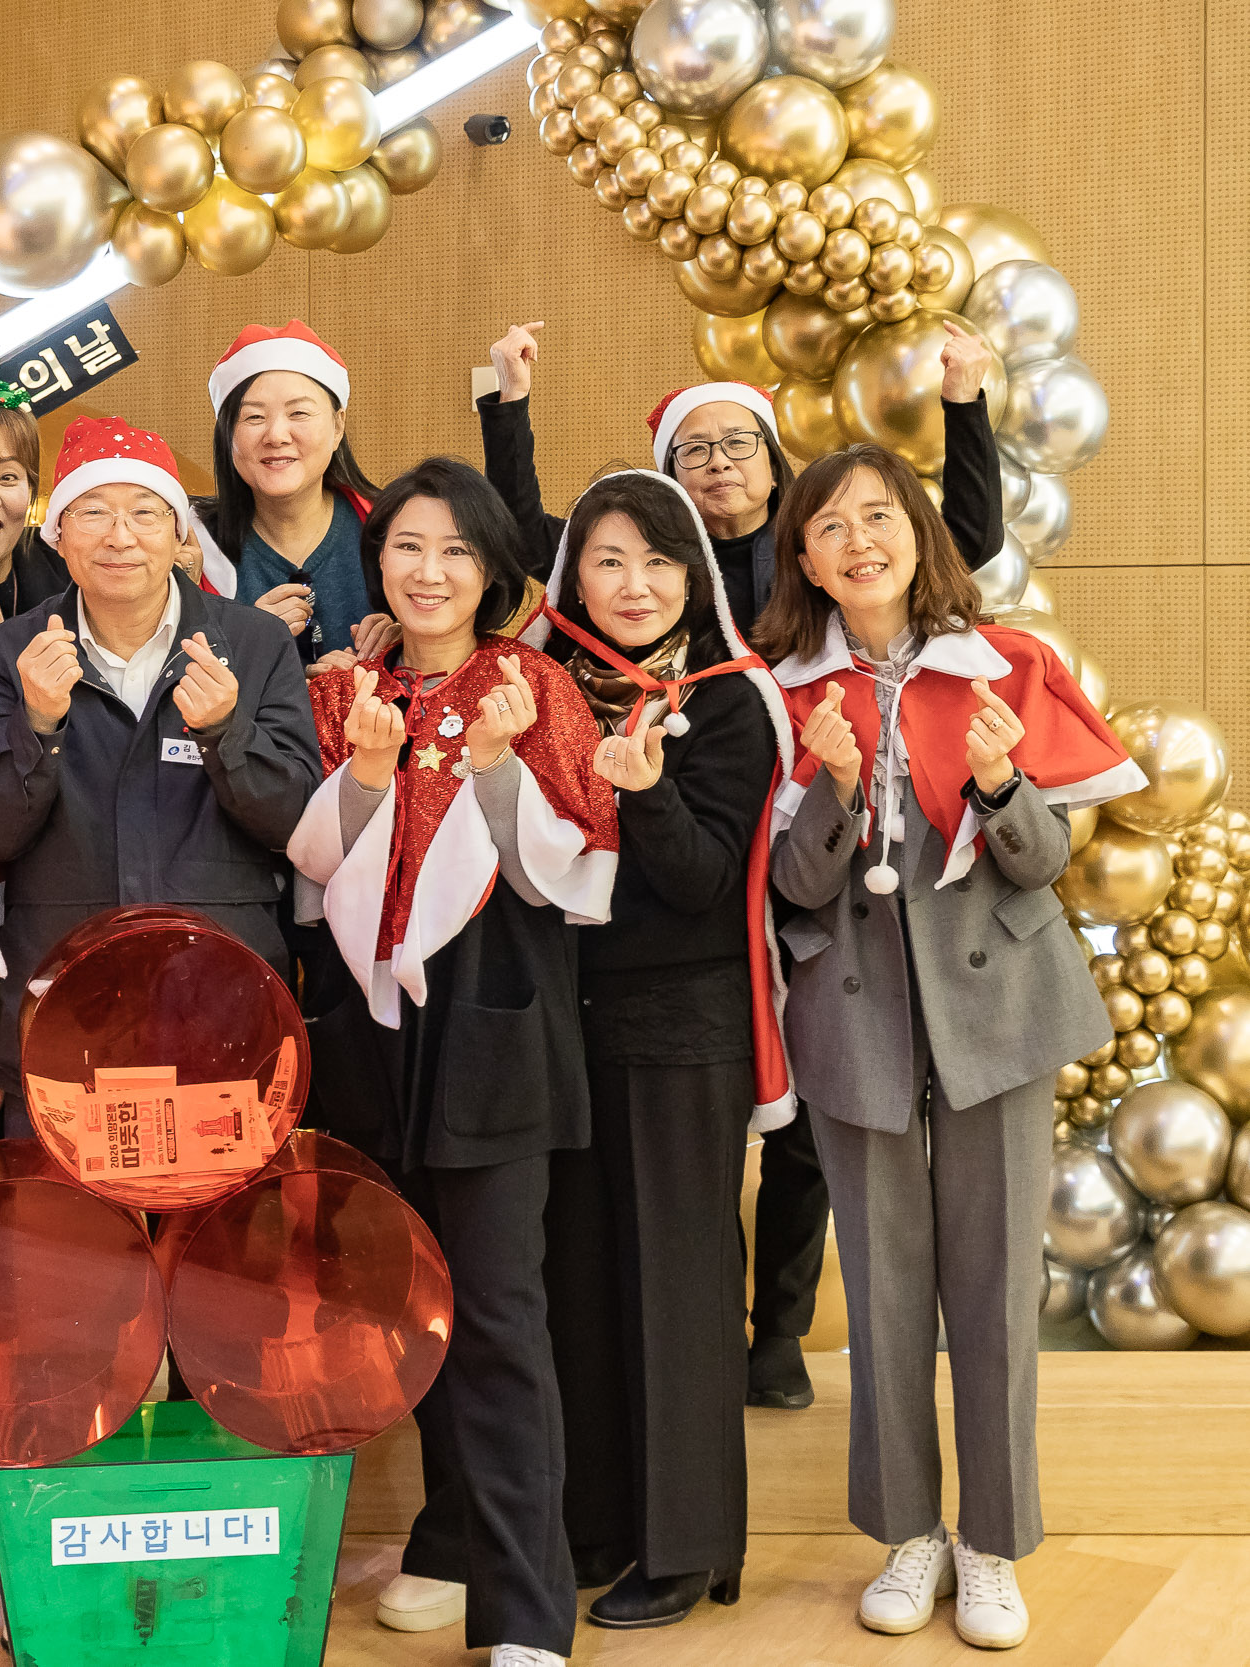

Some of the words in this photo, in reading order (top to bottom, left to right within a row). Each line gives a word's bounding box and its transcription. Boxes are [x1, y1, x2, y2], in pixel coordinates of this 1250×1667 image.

[63, 319, 123, 376] 날
[109, 1144, 119, 1168] 2026
[118, 1101, 139, 1168] 따뜻한
[57, 1515, 271, 1558] 감사합니다!
